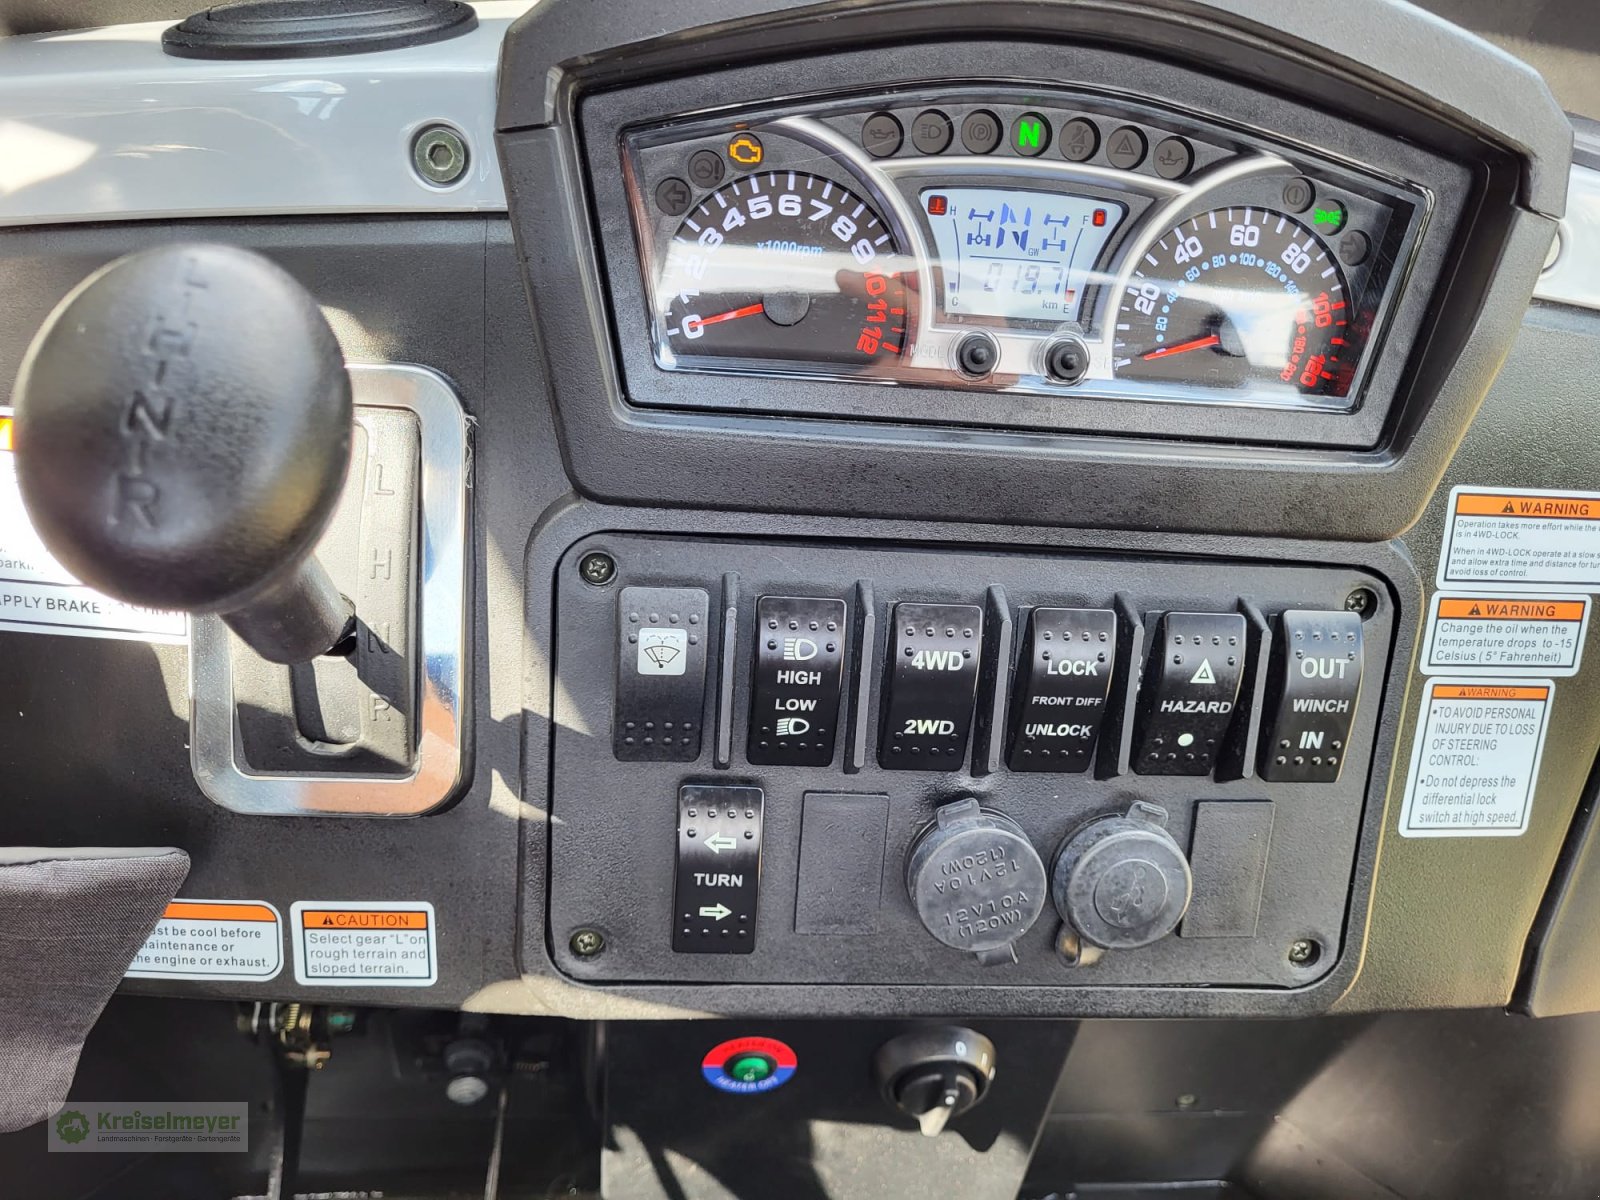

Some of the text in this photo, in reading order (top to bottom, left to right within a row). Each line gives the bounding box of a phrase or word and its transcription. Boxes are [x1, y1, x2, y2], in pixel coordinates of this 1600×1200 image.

[1018, 121, 1041, 148] N
[747, 195, 772, 220] 5
[778, 194, 802, 217] 6
[807, 200, 833, 222] 7
[722, 207, 746, 232] 4
[831, 215, 857, 242] 8
[1230, 224, 1260, 247] 60
[698, 227, 724, 250] 3
[851, 238, 876, 265] 9
[1174, 235, 1204, 264] 40
[1212, 254, 1226, 268] 80
[1239, 252, 1256, 266] 100
[1281, 243, 1311, 274] 80
[1185, 265, 1201, 282] 60
[1042, 300, 1058, 310] km
[1134, 282, 1161, 315] 20
[1313, 292, 1332, 328] 100
[1155, 316, 1168, 331] 20
[1520, 501, 1590, 515] WARNING
[1457, 520, 1497, 529] Operation
[1498, 521, 1519, 530] takes
[1542, 522, 1562, 531] effort
[1564, 523, 1585, 532] while
[1586, 524, 1597, 532] the
[1455, 530, 1463, 538] is
[1464, 530, 1471, 538] in
[1453, 547, 1476, 555] When
[1486, 548, 1531, 556] 4WD-LOCK
[1532, 550, 1561, 559] operate
[1578, 551, 1595, 559] slow
[369, 547, 392, 580] H
[1451, 558, 1466, 566] and
[1468, 558, 1488, 566] allow
[1489, 559, 1510, 567] extra
[1546, 560, 1577, 568] distance
[1578, 560, 1589, 568] for
[1450, 568, 1471, 576] avoid
[1472, 568, 1488, 576] loss
[1490, 568, 1499, 576] of
[46, 598, 101, 614] BRAKE
[1486, 604, 1556, 617] WARNING
[1441, 622, 1568, 635] Change the oil when the
[1438, 637, 1504, 648] temperature
[1507, 637, 1537, 649] drops
[1542, 638, 1553, 648] to
[911, 650, 964, 671] 4WD
[1435, 650, 1476, 661] Celsius
[1500, 651, 1562, 664] Fahrenheit)
[1047, 660, 1098, 676] LOCK
[1300, 657, 1349, 679] OUT
[776, 670, 822, 685] HIGH
[1467, 688, 1516, 697] WARNING
[775, 698, 817, 712] LOW
[1031, 696, 1102, 707] FRONT DIFF
[1160, 700, 1232, 714] HAZARD
[1292, 699, 1350, 713] WINCH
[1453, 707, 1483, 719] AVOID
[1484, 707, 1536, 720] PERSONAL
[903, 720, 955, 735] 2WD
[1025, 723, 1093, 737] UNLOCK
[1435, 722, 1535, 735] INJURY DUE TO LOSS
[1298, 731, 1324, 749] IN
[1432, 739, 1498, 750] OF STEERING
[1425, 775, 1516, 789] Do not depress the
[1422, 793, 1497, 805] differential lock
[1419, 811, 1518, 826] switch at high speed.
[693, 873, 743, 887] TURN
[336, 915, 409, 926] CAUTION
[172, 926, 187, 937] be
[190, 927, 217, 937] cool
[220, 927, 262, 939] before
[309, 933, 352, 944] Select
[355, 934, 386, 947] gear
[221, 943, 235, 952] or
[154, 956, 196, 967] engine
[200, 957, 212, 965] or
[216, 956, 270, 968] exhaust.
[310, 949, 426, 961] rough terrain and
[311, 963, 409, 976] sloped terrain.
